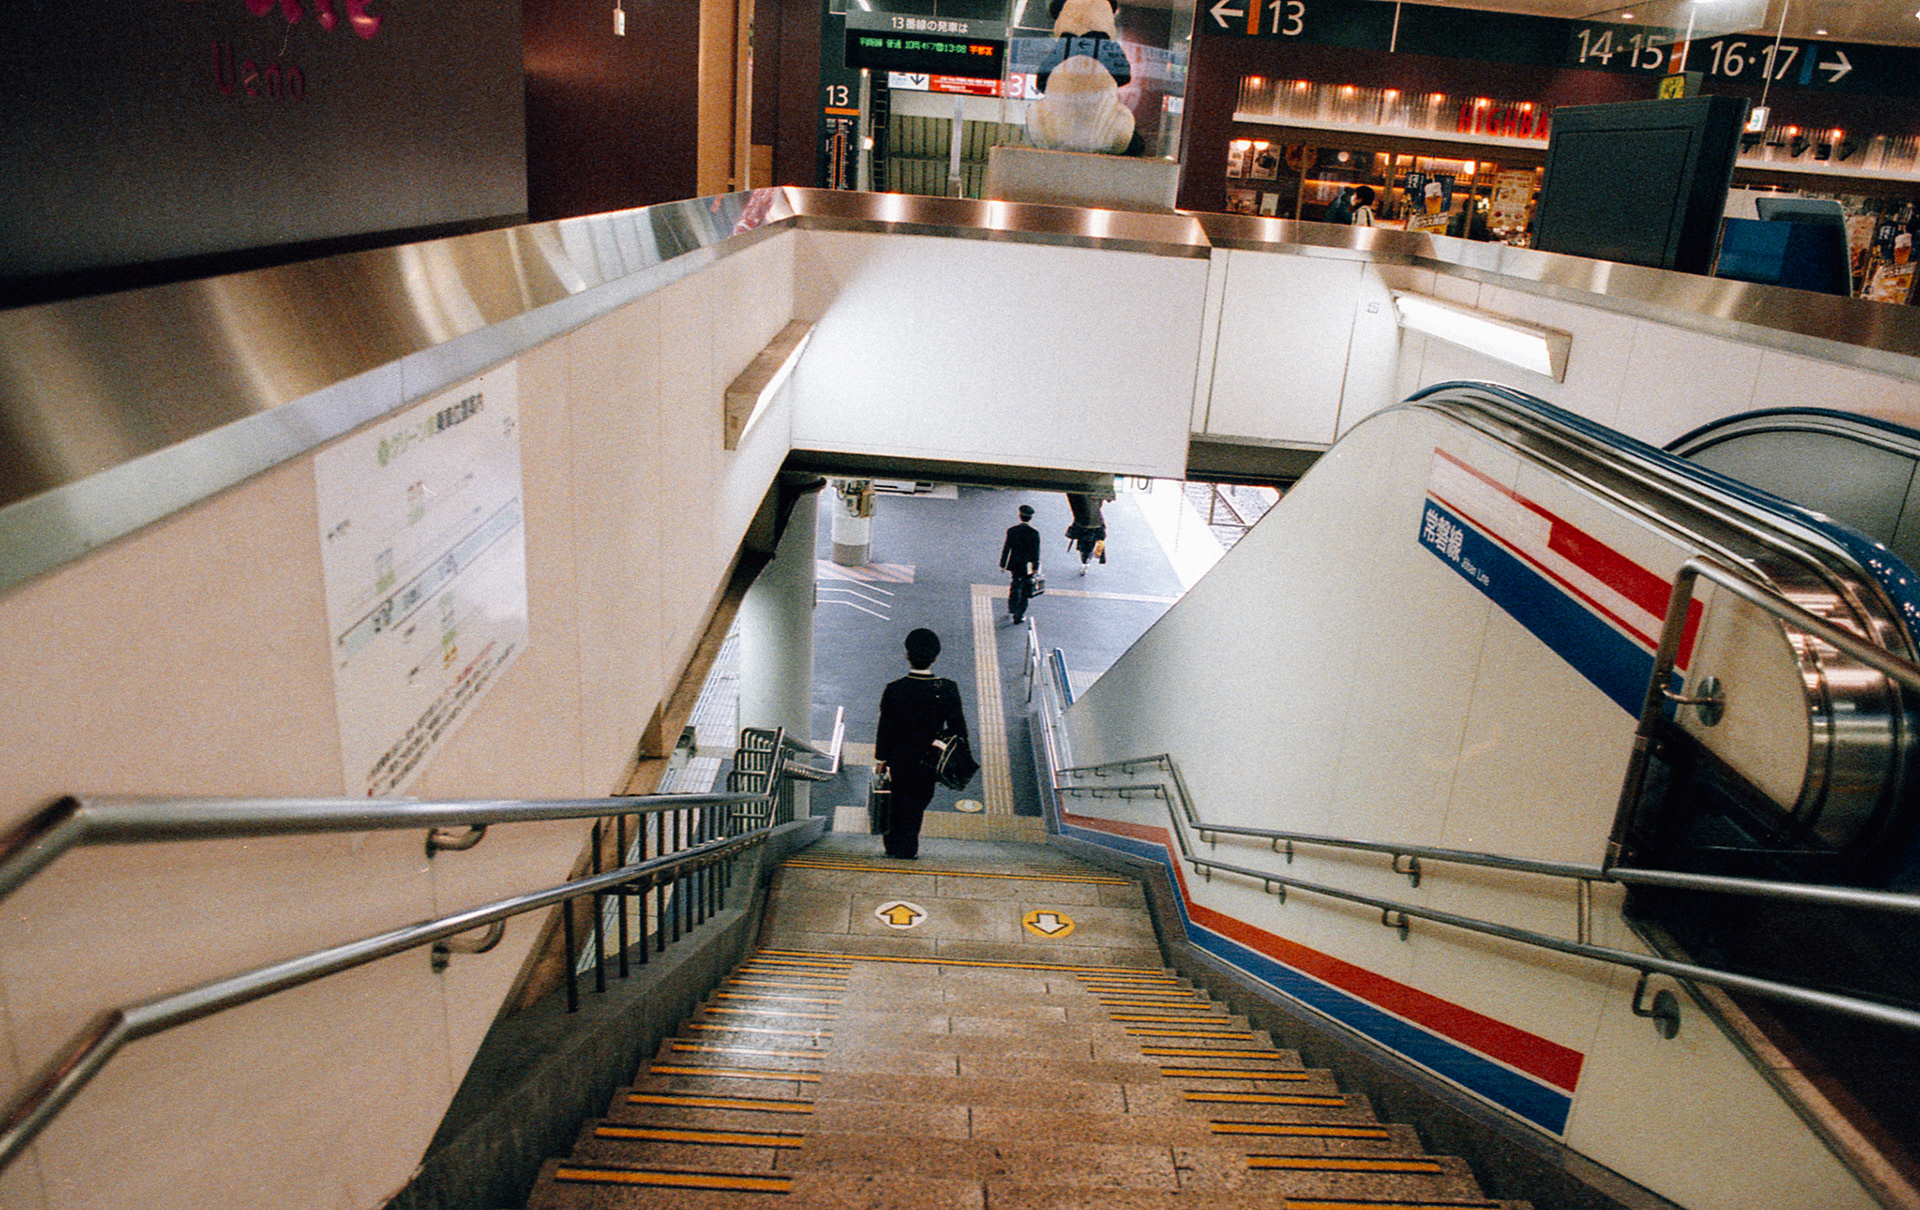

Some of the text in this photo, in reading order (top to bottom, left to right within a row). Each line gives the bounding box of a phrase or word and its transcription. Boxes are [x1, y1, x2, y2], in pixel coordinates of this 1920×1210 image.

[1267, 0, 1303, 36] 13
[212, 38, 304, 101] Ueno
[825, 84, 849, 107] 13
[1456, 103, 1548, 141] HIGHBA
[1423, 508, 1464, 562] 常磐線
